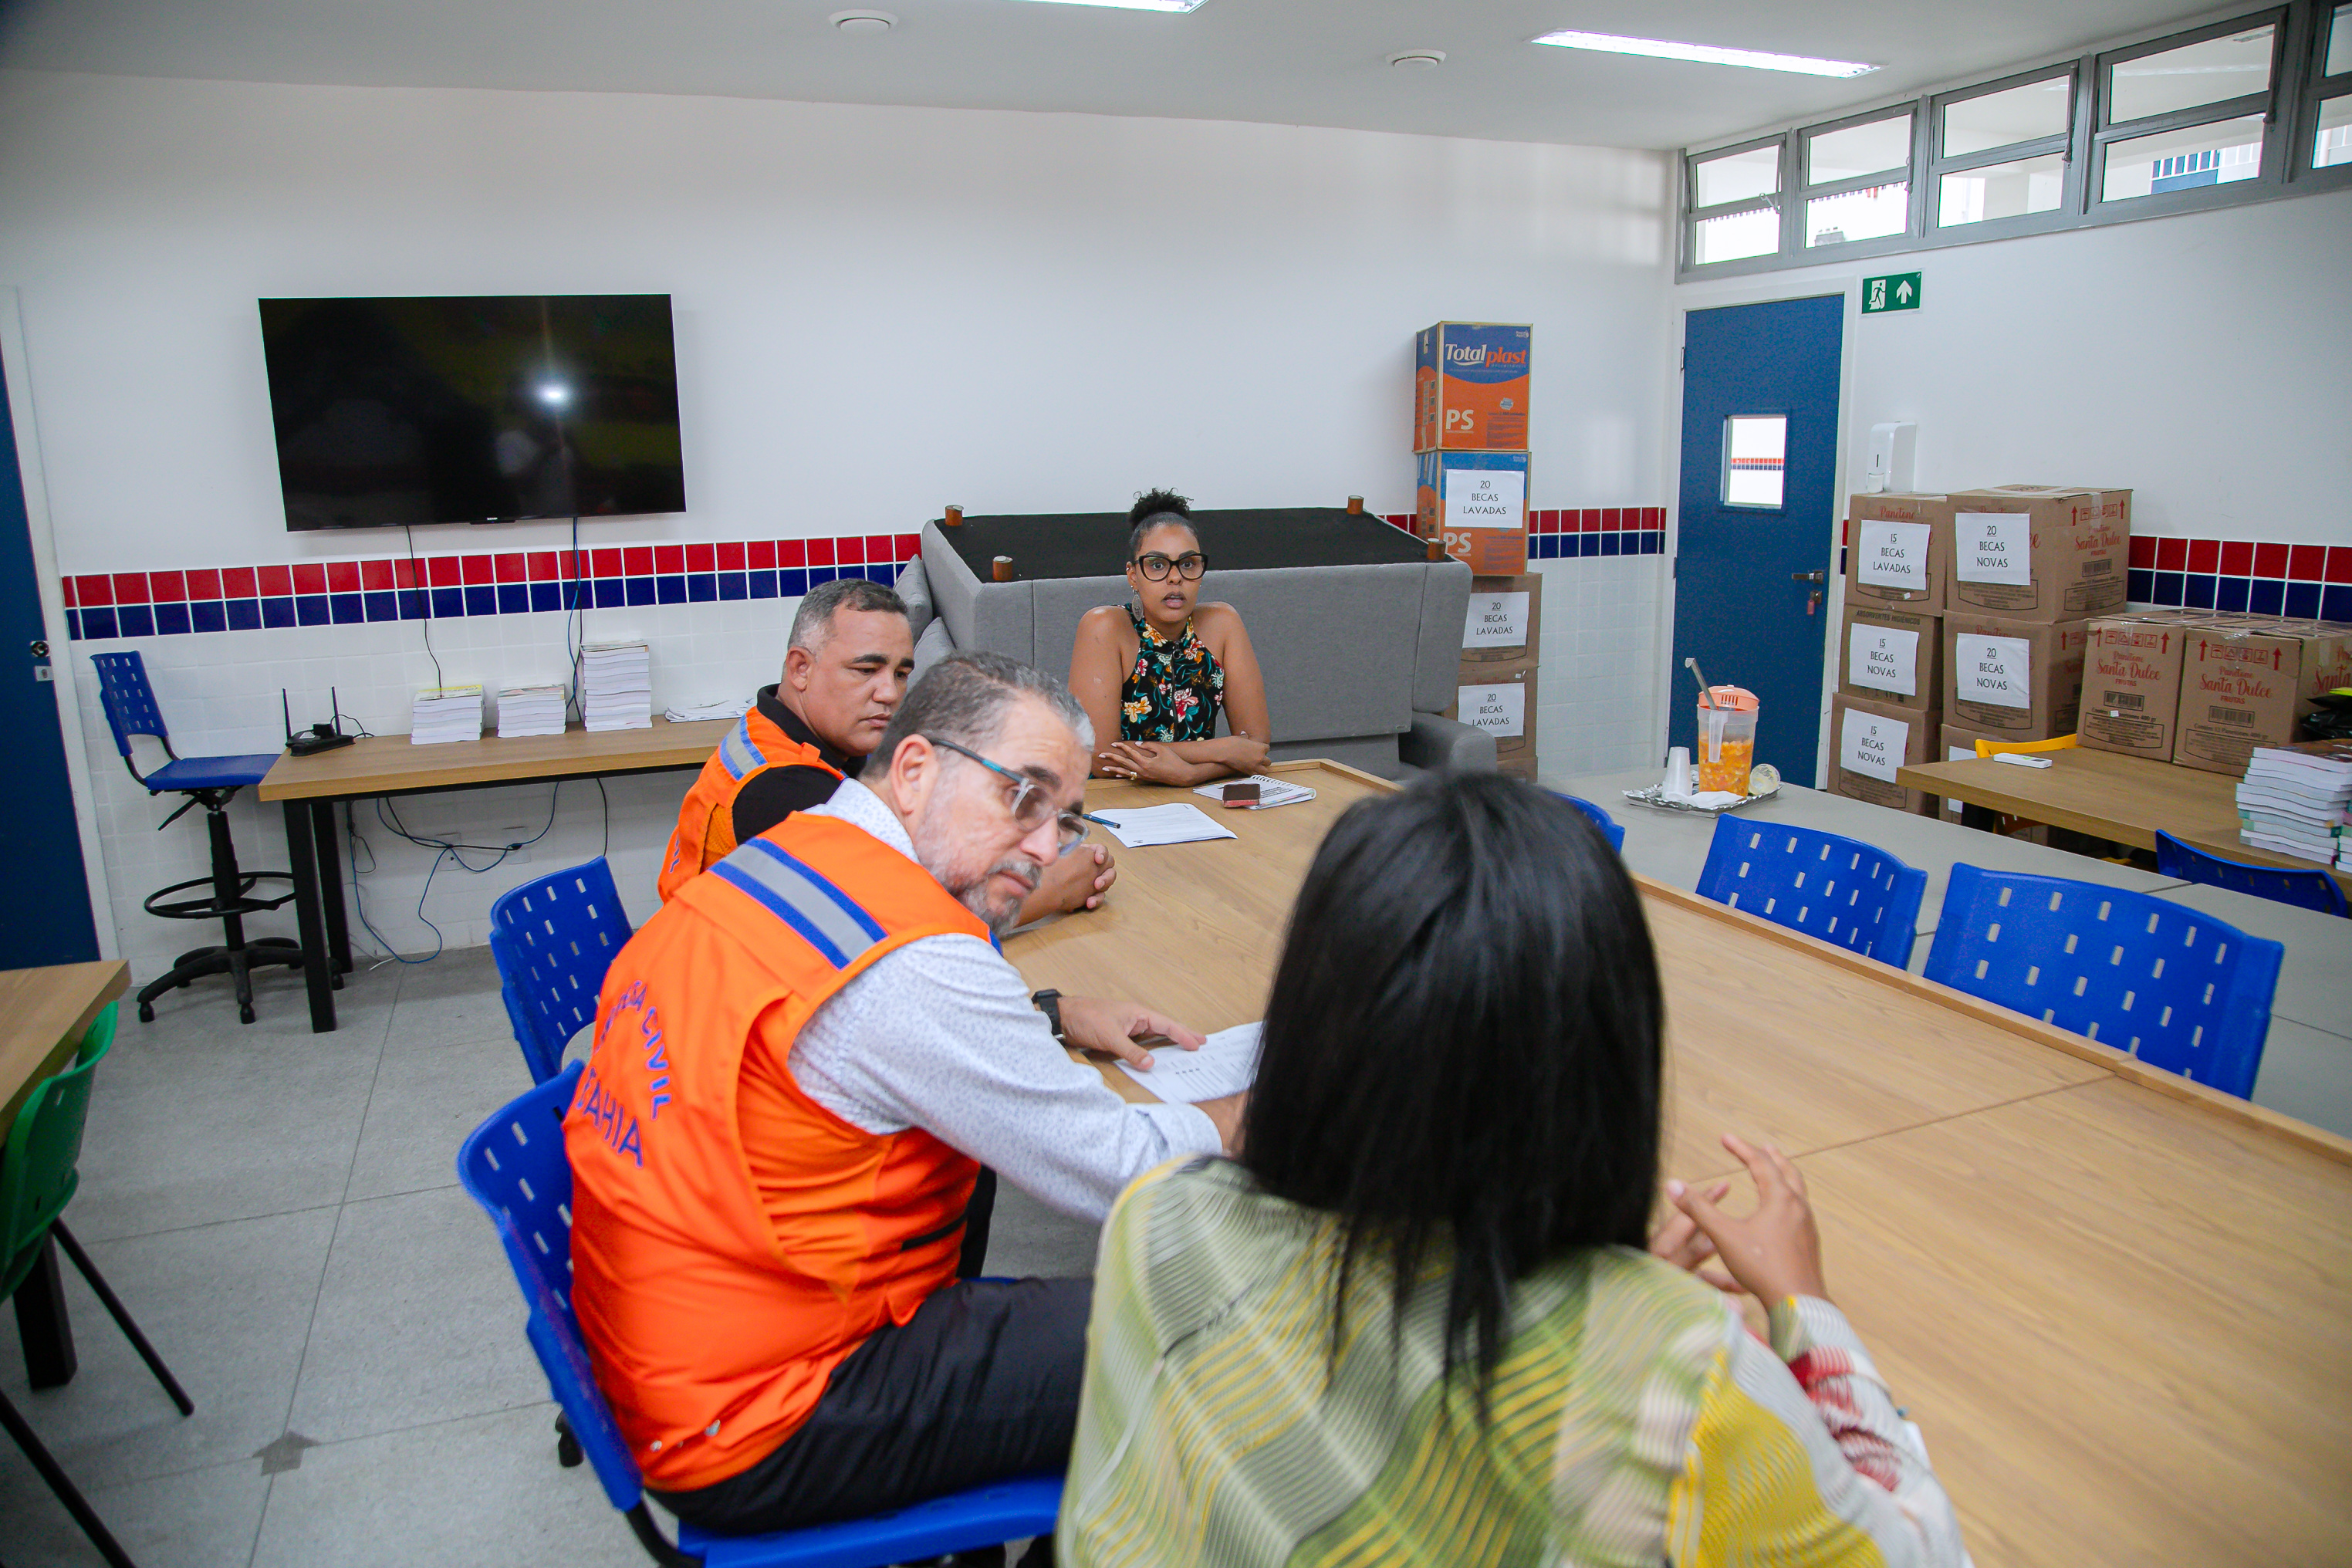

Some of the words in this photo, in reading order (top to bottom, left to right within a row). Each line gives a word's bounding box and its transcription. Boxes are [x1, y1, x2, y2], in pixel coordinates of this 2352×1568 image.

[1445, 409, 1474, 430] PS
[1480, 480, 1491, 488] 20
[1472, 493, 1499, 502] BECAS
[1463, 506, 1506, 515] LAVADAS
[1987, 525, 1997, 536] 20
[1443, 532, 1472, 553] PS
[1891, 533, 1897, 542] 15
[1979, 541, 2005, 552] BECAS
[1881, 547, 1904, 559] BECAS
[1873, 561, 1911, 574] LAVADAS
[1976, 557, 2009, 568] NOVAS
[1492, 602, 1502, 610] 20
[1484, 614, 1508, 623] BECAS
[1476, 626, 1513, 636] LAVADAS
[1879, 638, 1886, 647] 15
[1870, 651, 1894, 664] BECAS
[1987, 647, 1997, 657] 20
[1867, 664, 1896, 678] NOVAS
[1979, 662, 2004, 674] BECAS
[2097, 658, 2127, 678] Santa
[2130, 662, 2161, 681] Dulce
[1976, 678, 2008, 691] NOVAS
[2199, 673, 2232, 693] Santa
[2236, 678, 2273, 699] Dulce
[1479, 705, 1503, 715] BECAS
[1472, 717, 1510, 727] LAVADAS
[1870, 725, 1877, 735] 15
[1861, 737, 1884, 751] BECAS
[1857, 750, 1886, 766] NOVAS
[639, 1005, 673, 1121] CIVIL
